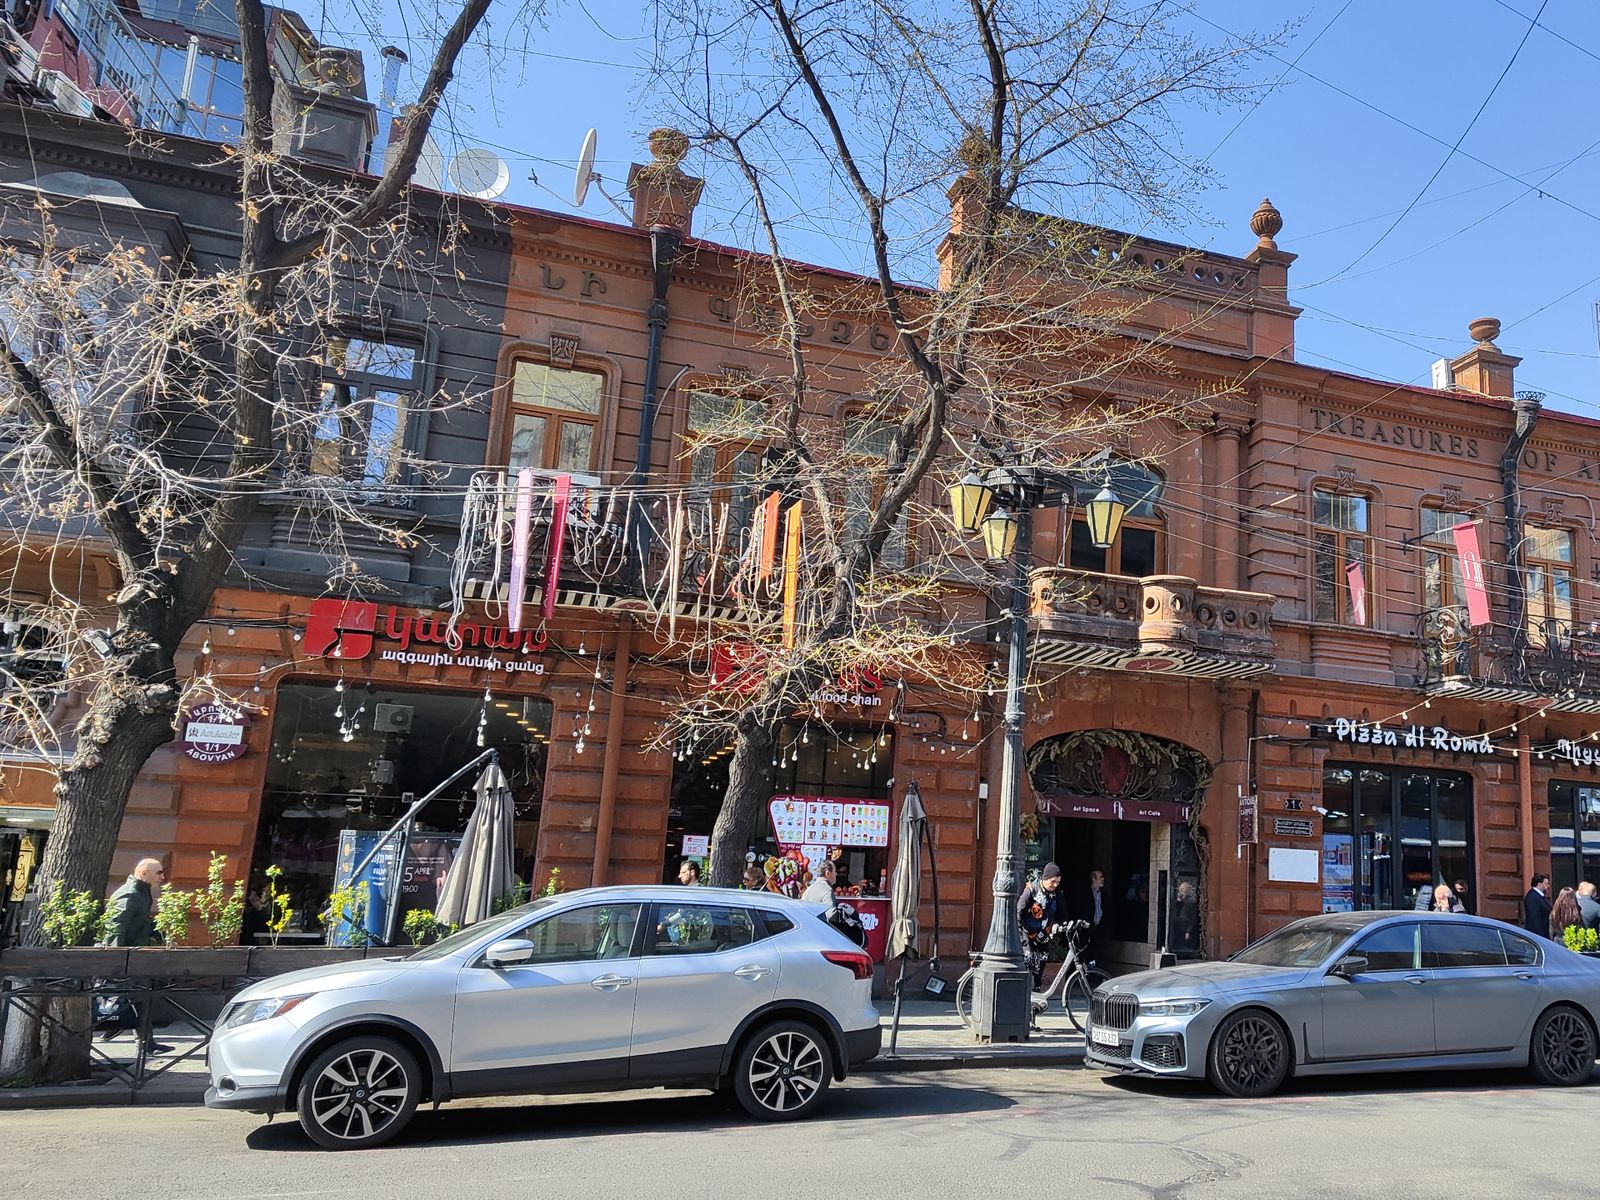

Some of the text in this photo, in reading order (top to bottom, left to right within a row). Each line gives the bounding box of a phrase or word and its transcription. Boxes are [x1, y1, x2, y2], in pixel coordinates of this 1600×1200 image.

[1310, 409, 1479, 458] TREASURES
[1523, 451, 1557, 472] OF
[822, 691, 847, 704] food
[851, 693, 881, 706] chain
[1336, 717, 1493, 753] Pizza di Roma
[204, 743, 220, 752] 1/1
[187, 749, 234, 761] ABOVYAN
[1082, 806, 1100, 814] Space
[1291, 800, 1296, 809] 1
[403, 867, 413, 882] 5
